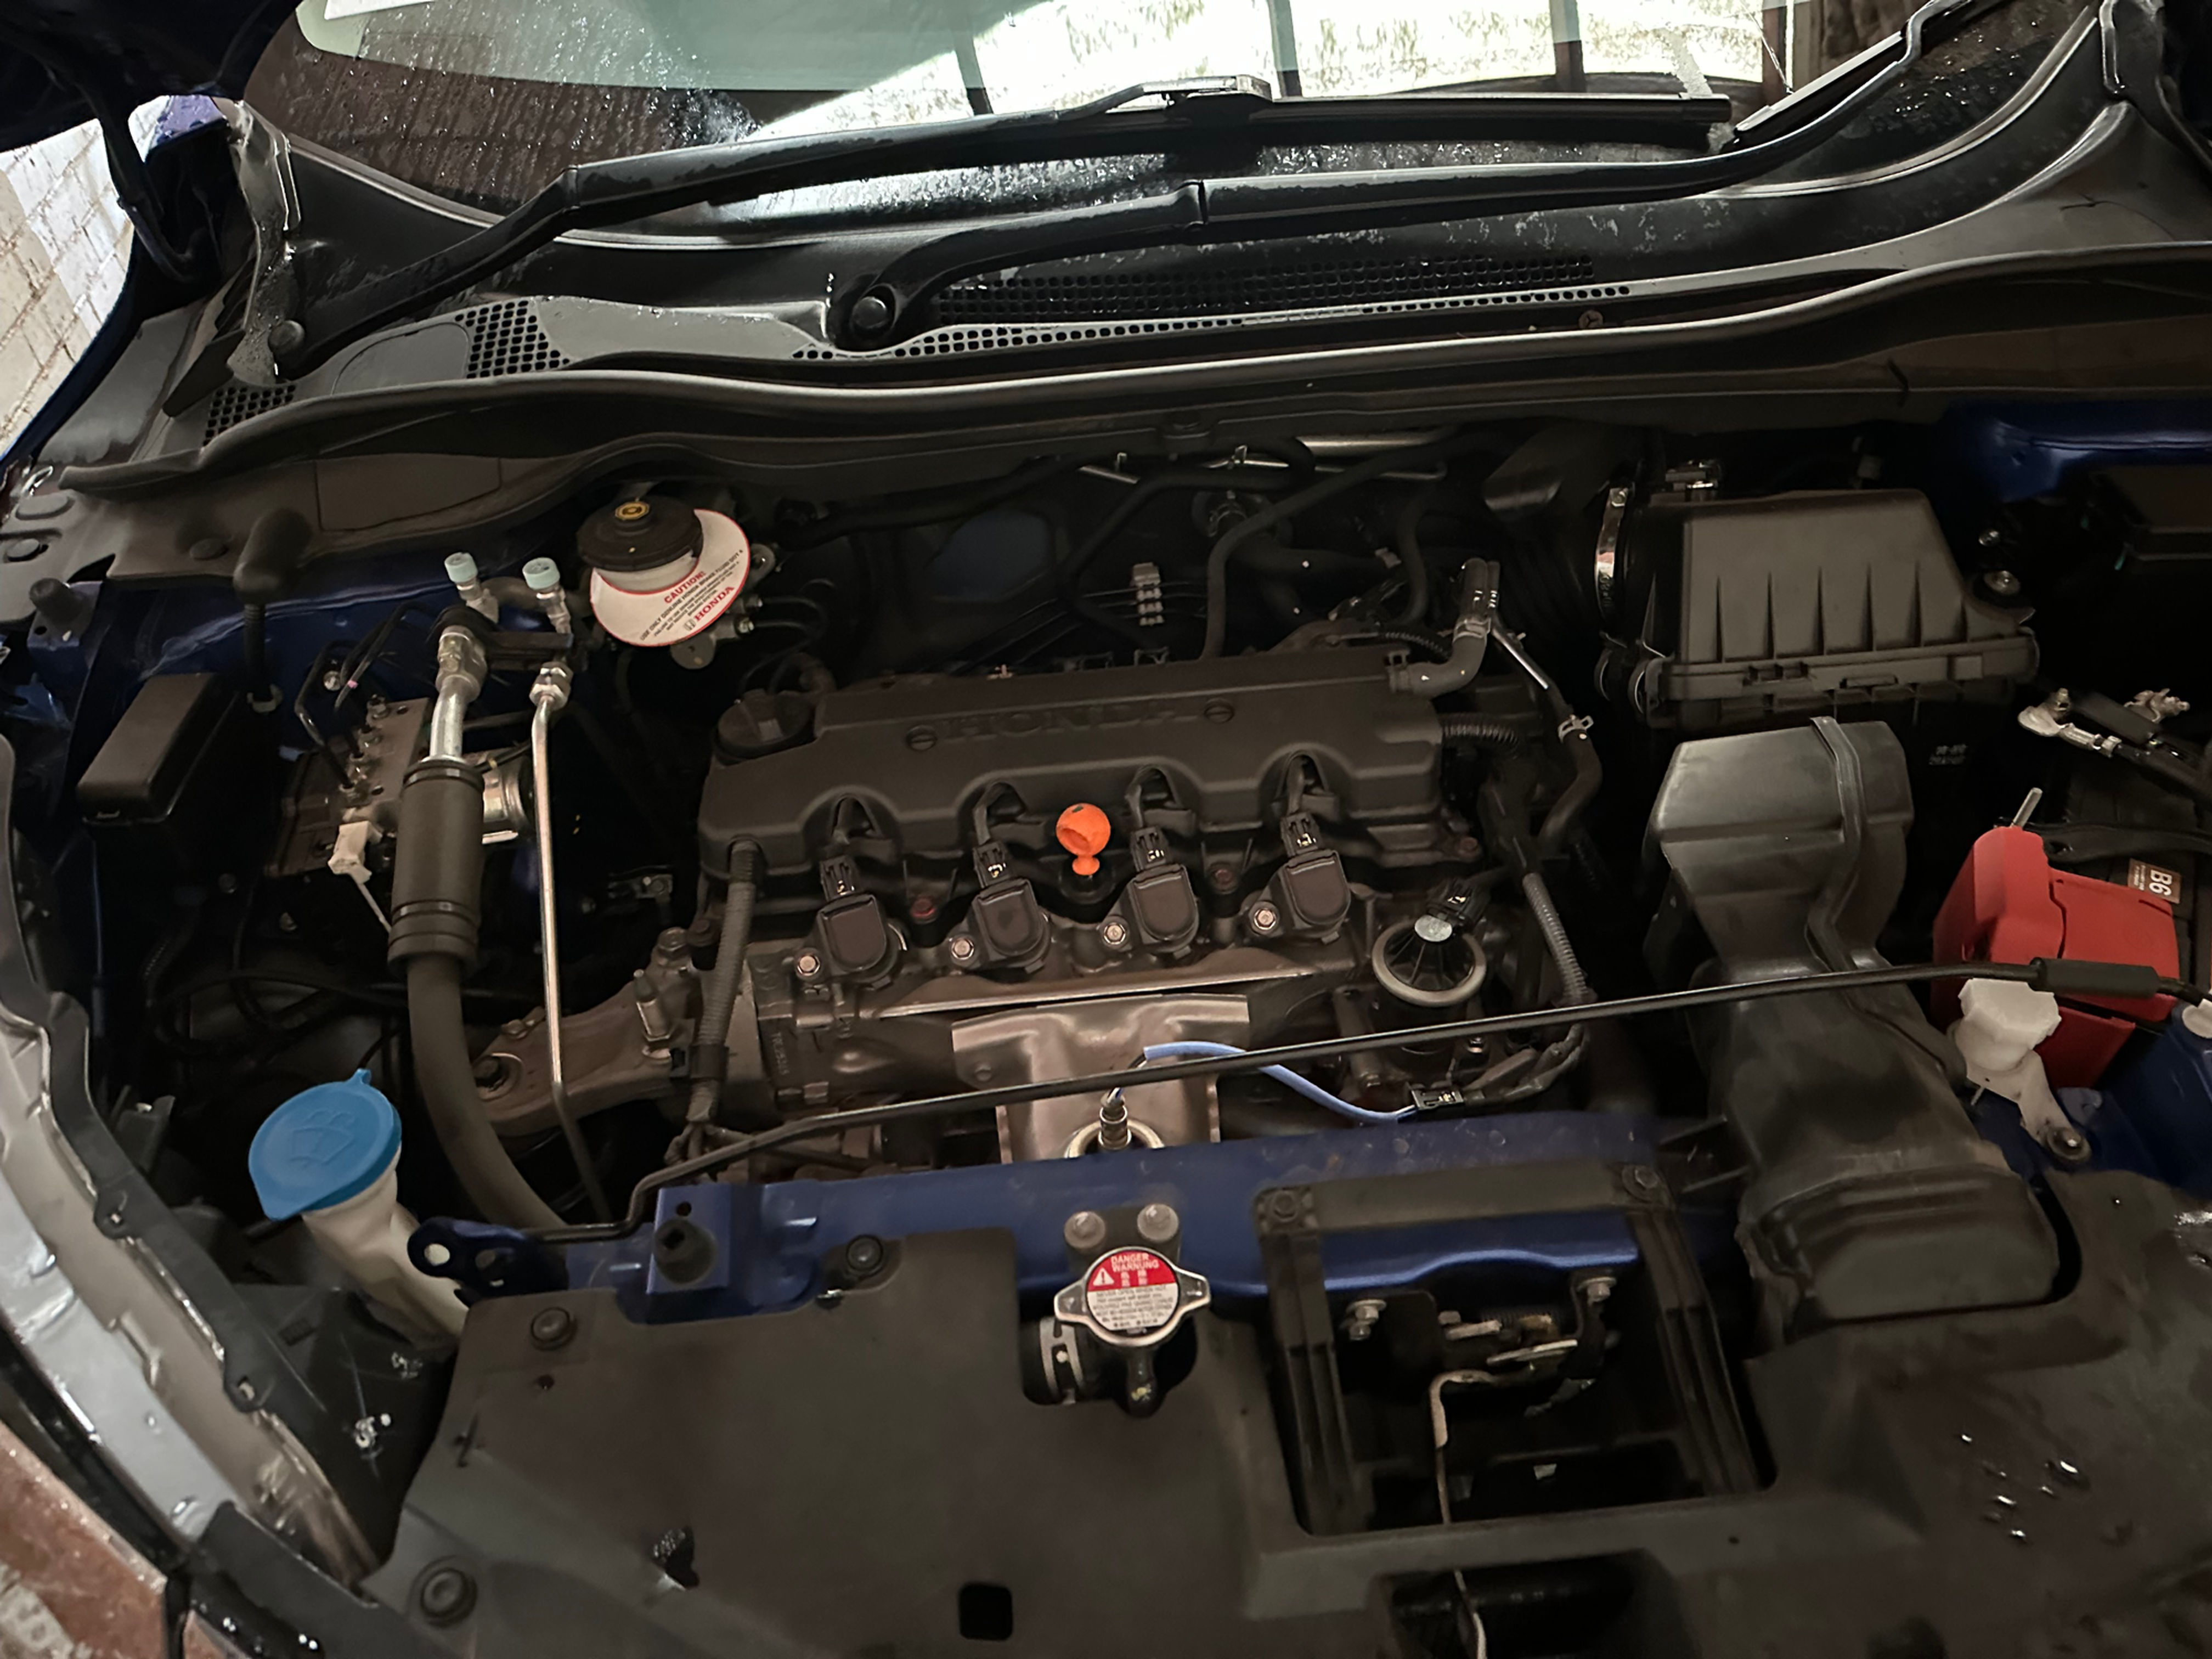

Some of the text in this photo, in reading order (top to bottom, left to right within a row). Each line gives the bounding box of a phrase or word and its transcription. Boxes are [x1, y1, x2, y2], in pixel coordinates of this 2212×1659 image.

[695, 586, 735, 622] HONDA
[2149, 870, 2172, 896] B6
[1111, 1252, 1149, 1263] DANGER
[1112, 1259, 1159, 1272] WARNUNG
